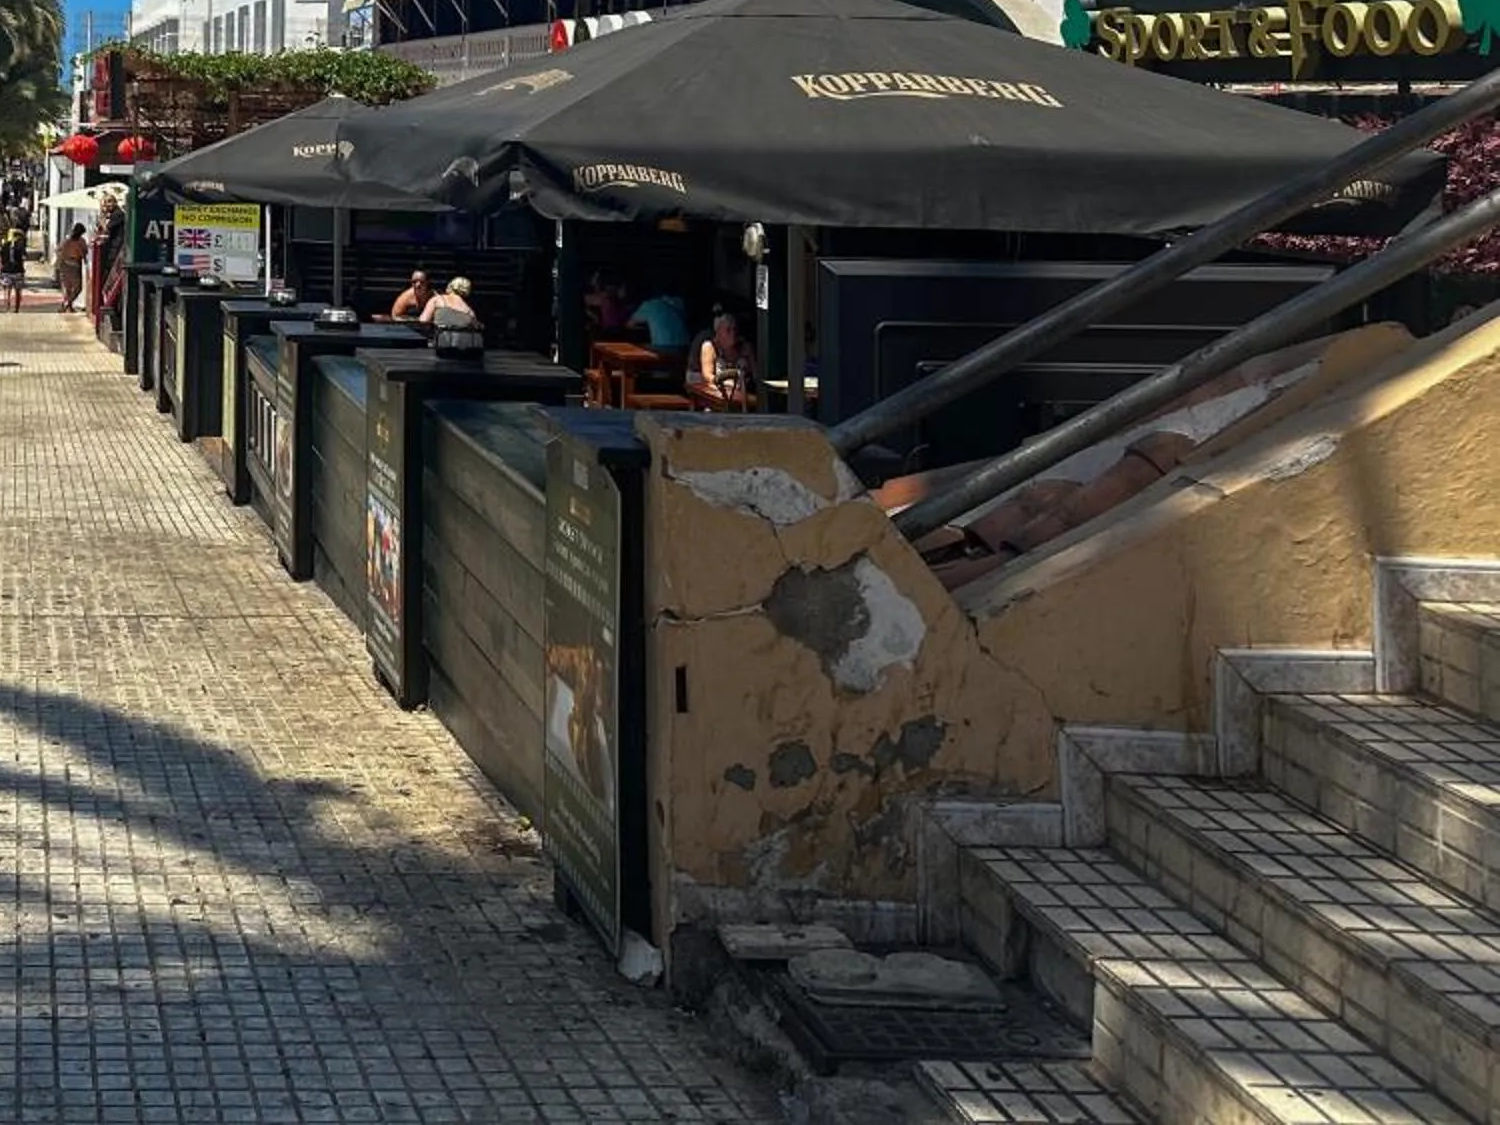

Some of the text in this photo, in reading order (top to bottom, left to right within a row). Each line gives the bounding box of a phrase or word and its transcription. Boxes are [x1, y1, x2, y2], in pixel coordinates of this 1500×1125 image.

[791, 72, 1064, 108] KOPPARBERG
[573, 163, 686, 194] KOPPARBERG
[145, 220, 174, 240] AT
